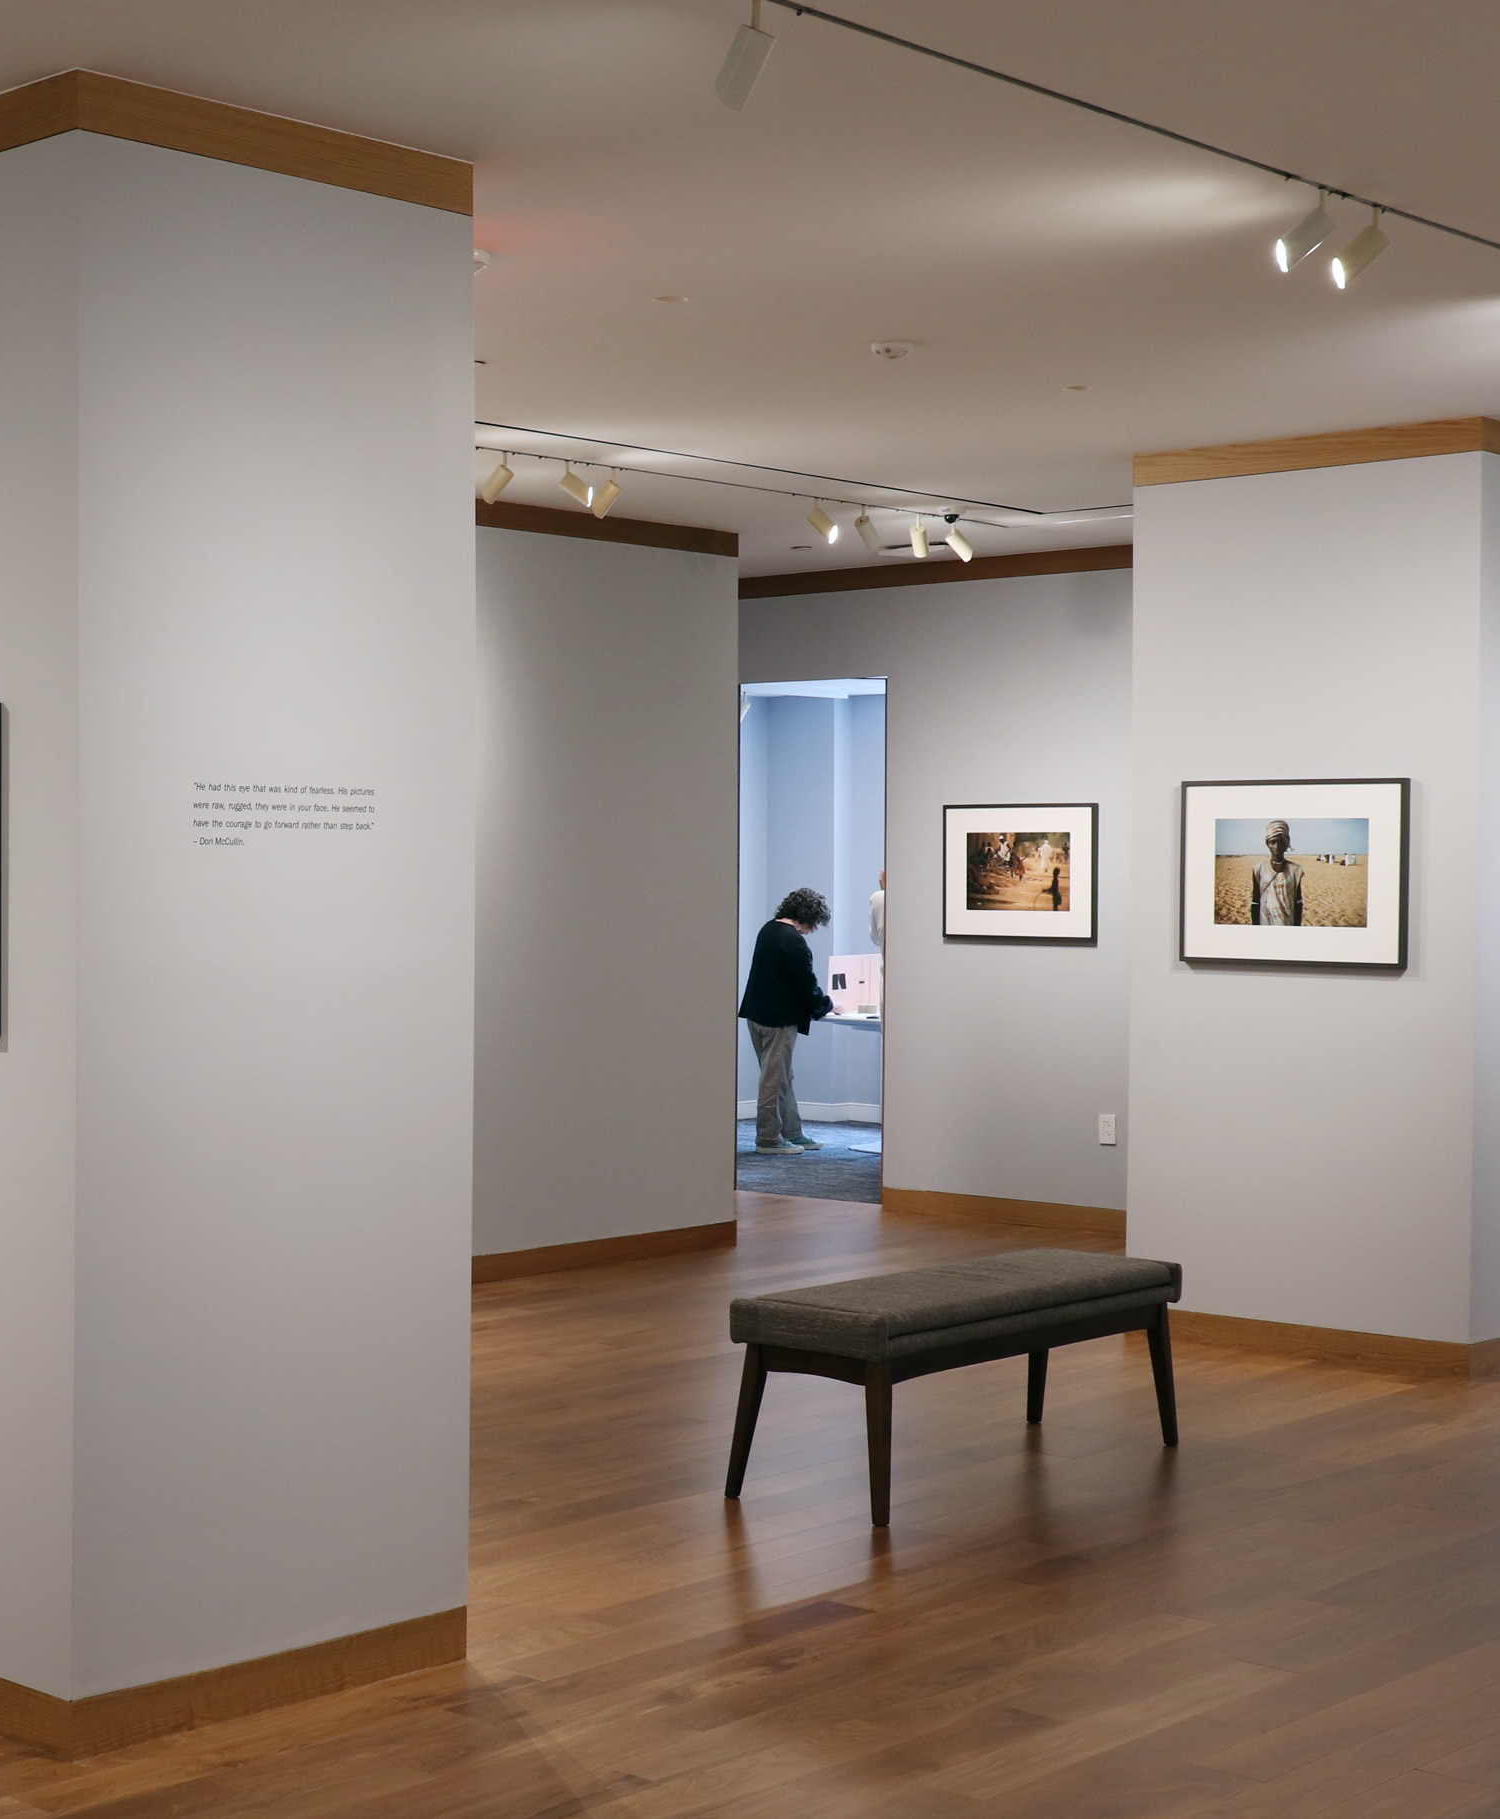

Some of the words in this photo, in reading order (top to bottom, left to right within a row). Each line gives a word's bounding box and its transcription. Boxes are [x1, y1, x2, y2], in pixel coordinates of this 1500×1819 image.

[209, 784, 222, 792] had
[224, 784, 237, 792] this
[239, 785, 250, 794] eye
[253, 785, 266, 793] that
[284, 785, 298, 794] kind
[300, 786, 307, 794] of
[309, 786, 335, 795] fearless.
[338, 787, 348, 795] His
[350, 787, 375, 796] pictures
[212, 802, 226, 810] raw,
[229, 803, 253, 812] rugged,
[255, 803, 270, 812] they
[289, 803, 295, 811] in
[297, 805, 312, 813] your
[314, 804, 329, 812] face.
[331, 804, 340, 812] He
[342, 805, 367, 813] seemed
[193, 819, 209, 827] have
[226, 821, 252, 830] courage
[264, 821, 272, 830] go
[340, 823, 354, 831] step
[200, 837, 213, 845] Don
[215, 837, 245, 846] McCullin.
